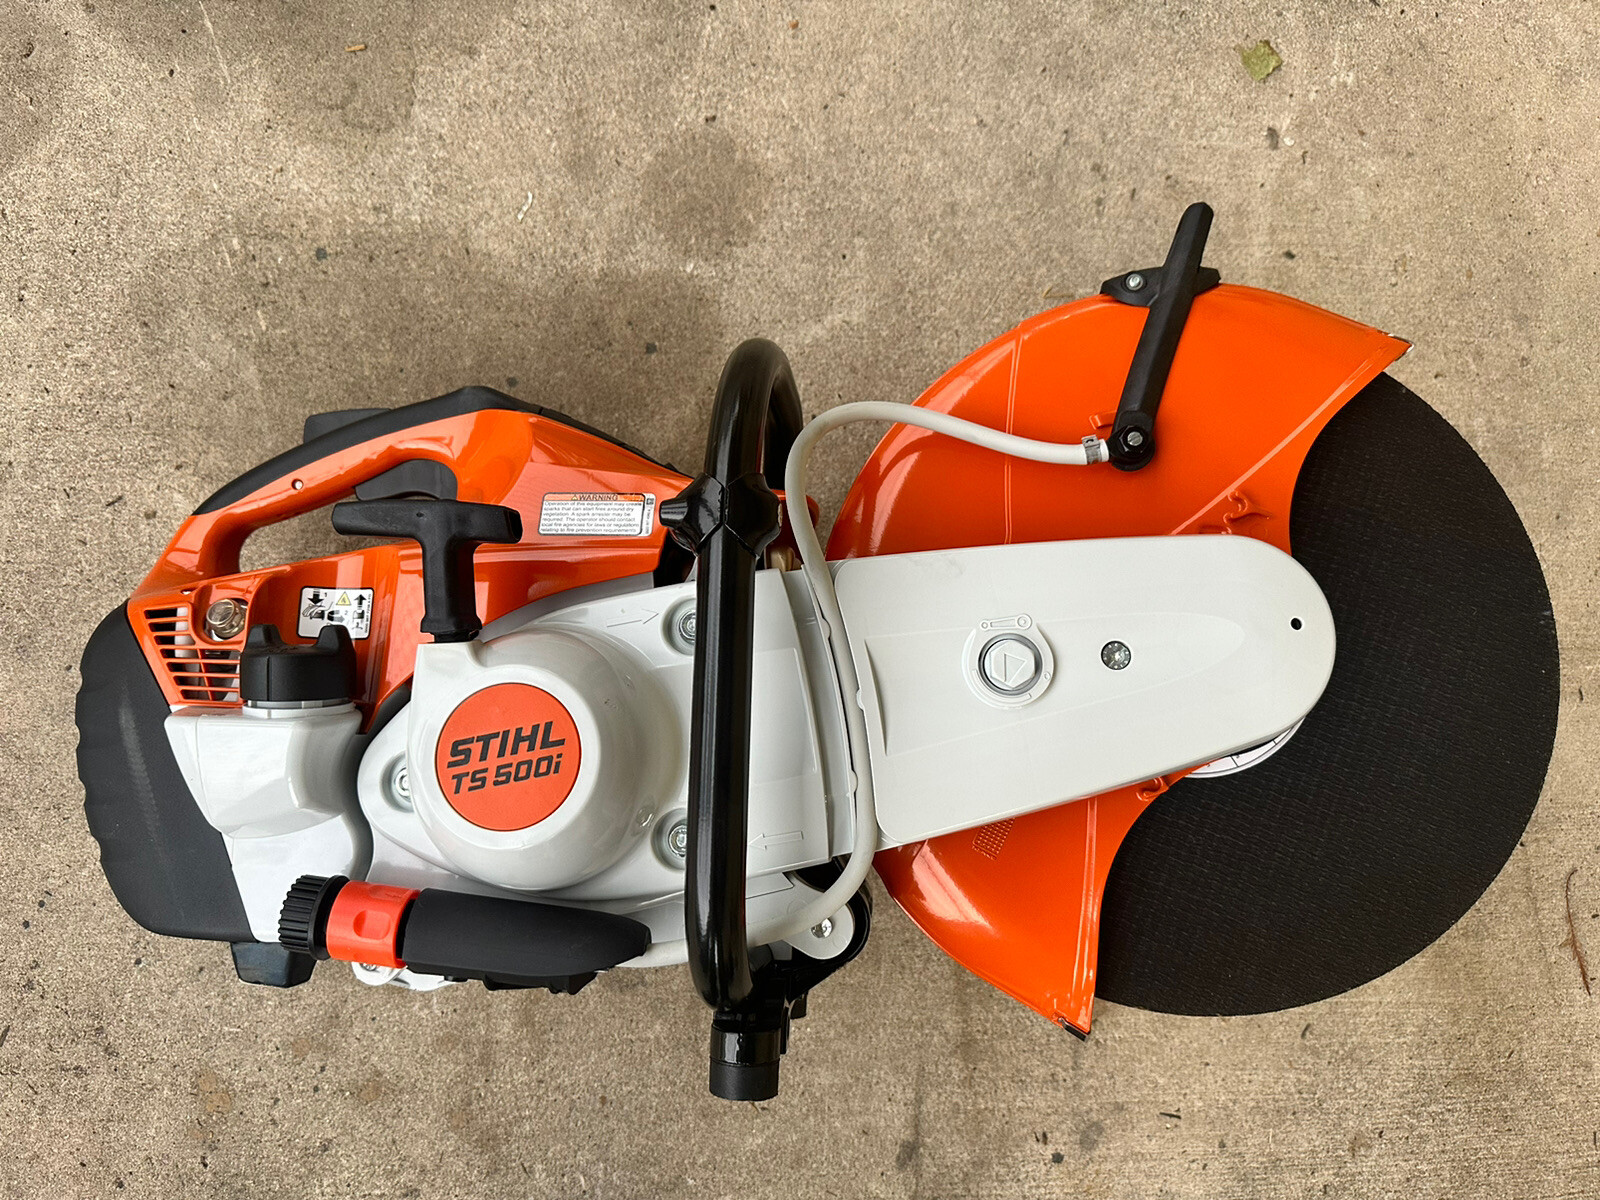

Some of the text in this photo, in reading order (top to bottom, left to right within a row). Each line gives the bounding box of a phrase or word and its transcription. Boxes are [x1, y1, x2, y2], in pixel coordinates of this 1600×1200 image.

[446, 721, 566, 768] STIHL
[452, 753, 562, 794] TS 500i
